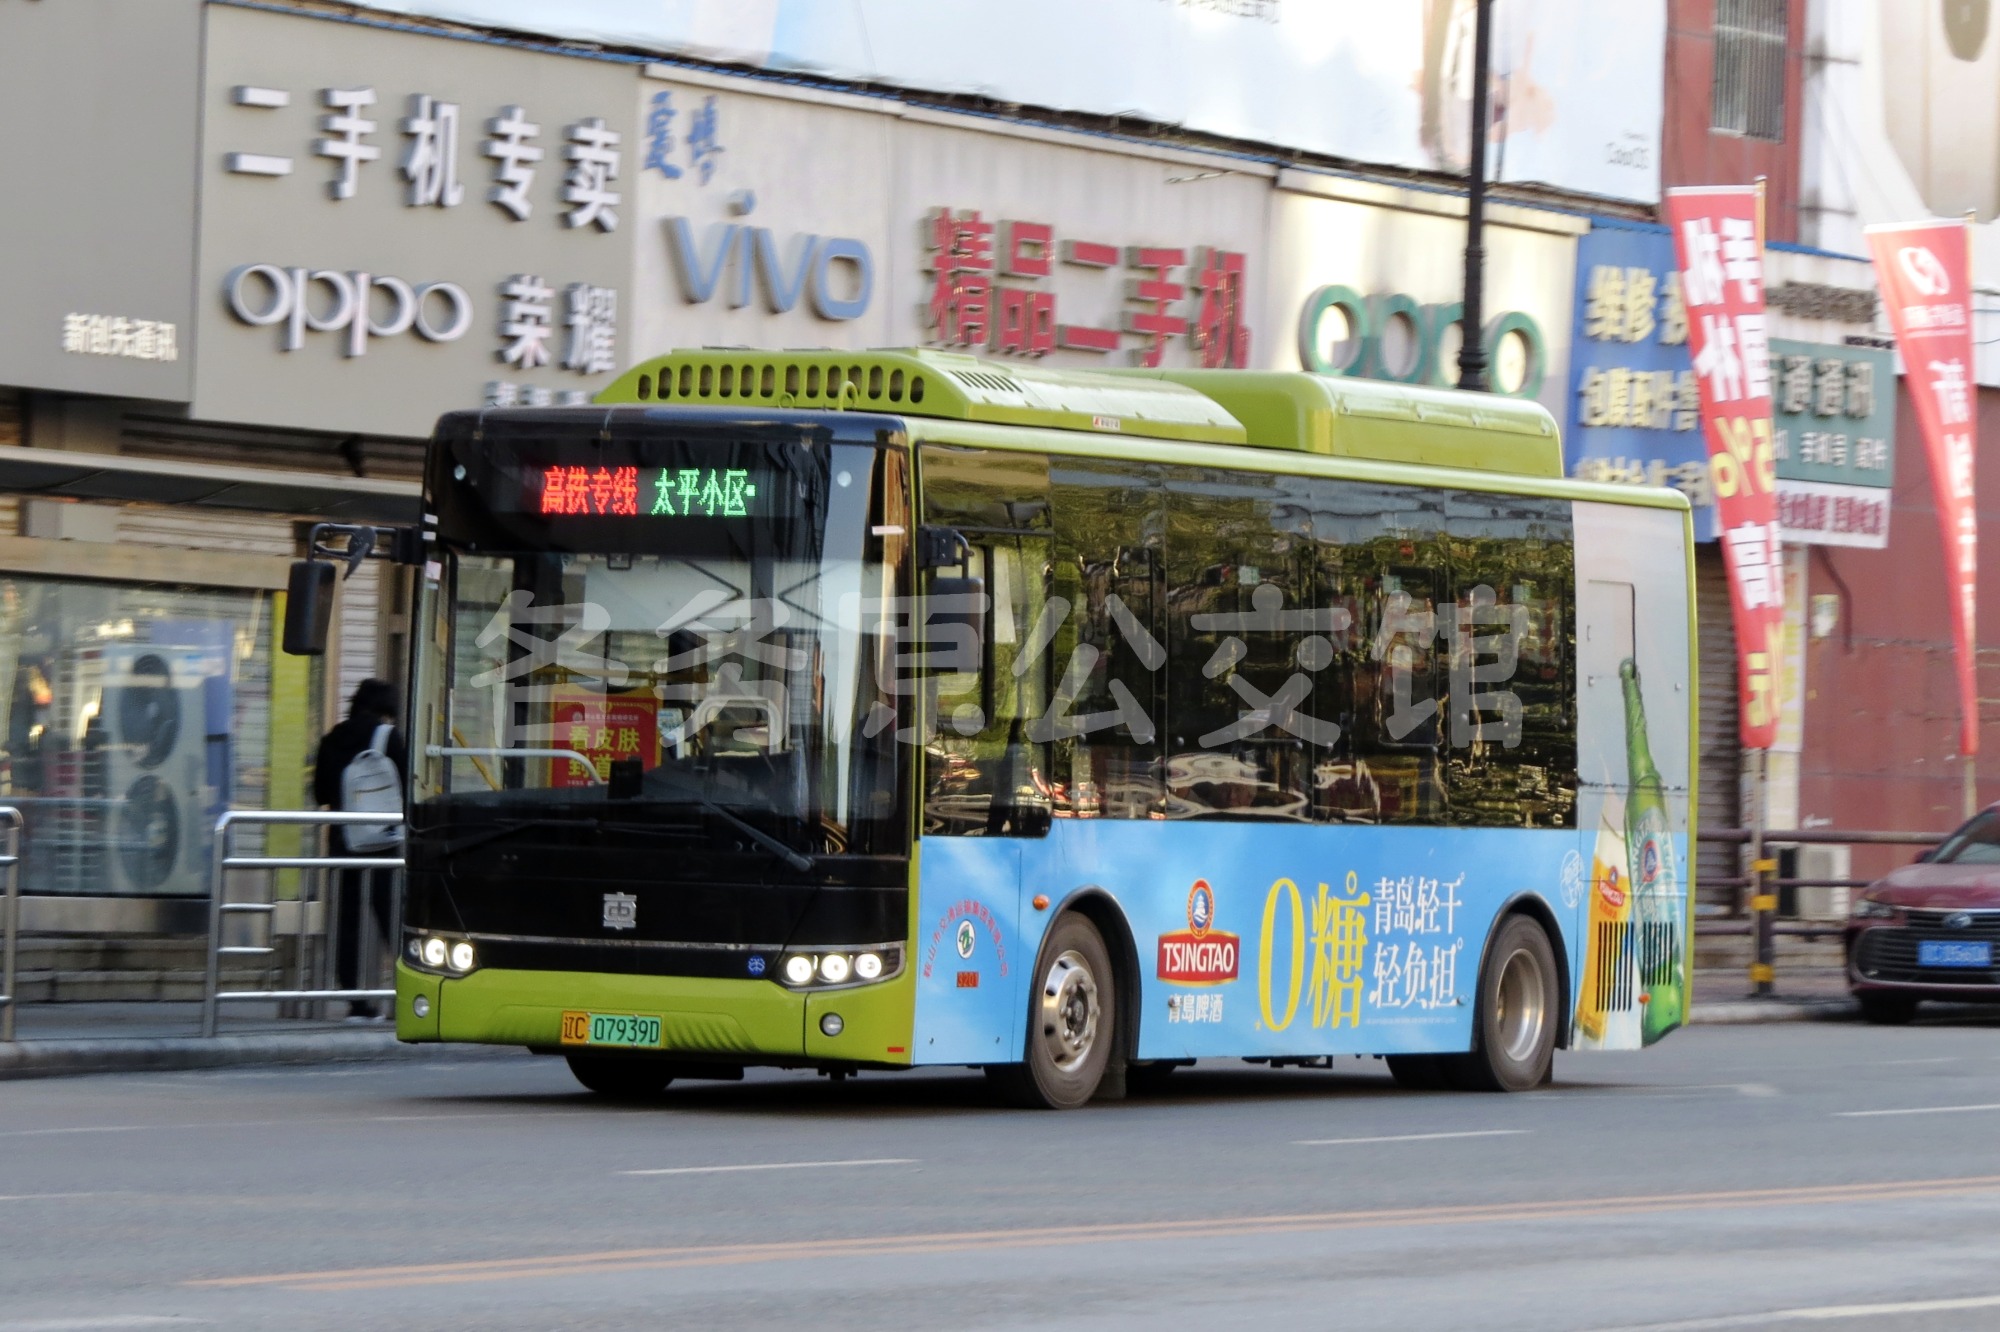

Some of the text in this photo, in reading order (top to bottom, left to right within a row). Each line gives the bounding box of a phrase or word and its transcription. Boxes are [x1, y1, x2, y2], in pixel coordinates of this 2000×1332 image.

[227, 86, 621, 231] 二手机专卖
[661, 189, 873, 321] vivo
[921, 206, 1251, 369] 精品二手机
[500, 274, 617, 375] 荣耀
[542, 465, 748, 517] 高铁专线 太平小区
[1163, 942, 1235, 973] TSINGTAO
[1368, 937, 1464, 1010] 轻负担
